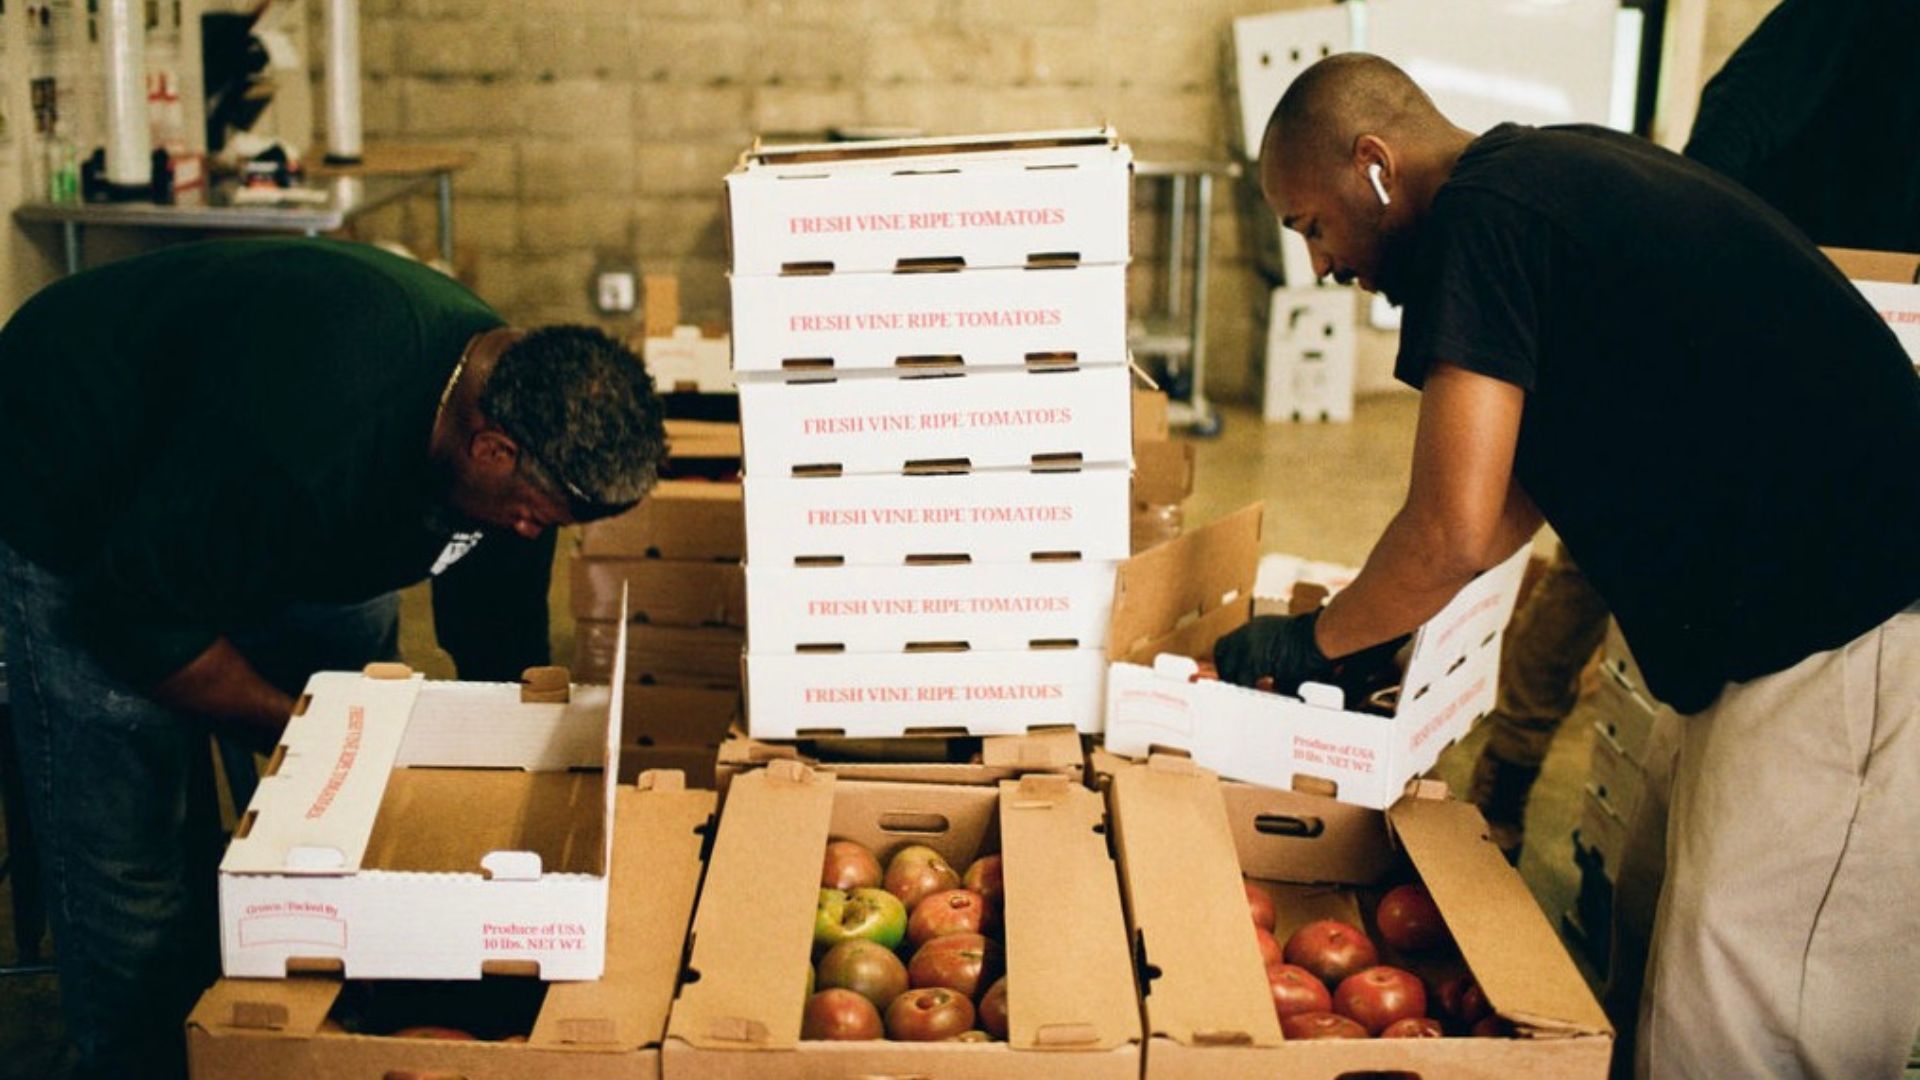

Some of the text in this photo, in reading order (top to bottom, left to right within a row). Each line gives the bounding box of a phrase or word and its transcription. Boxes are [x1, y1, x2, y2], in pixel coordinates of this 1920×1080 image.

[788, 207, 1066, 235] FRESH VINE RIPE TOMATOES
[788, 308, 1062, 333] FRESH VINE RIPE TOMATOES
[803, 408, 1072, 435] FRESH VINE RIPE TOMATOES
[806, 505, 1073, 527] FRESH VINE RIPE TOMATOES
[806, 595, 1070, 617] FRESH VINE RIPE TOMATOES
[804, 683, 1064, 704] FRESH VINE RIPE TOMATOES
[1293, 735, 1336, 753] Produce
[483, 923, 586, 936] Produce of USA
[484, 938, 499, 950] 10
[500, 938, 525, 950] lbs.
[527, 938, 555, 950] NET
